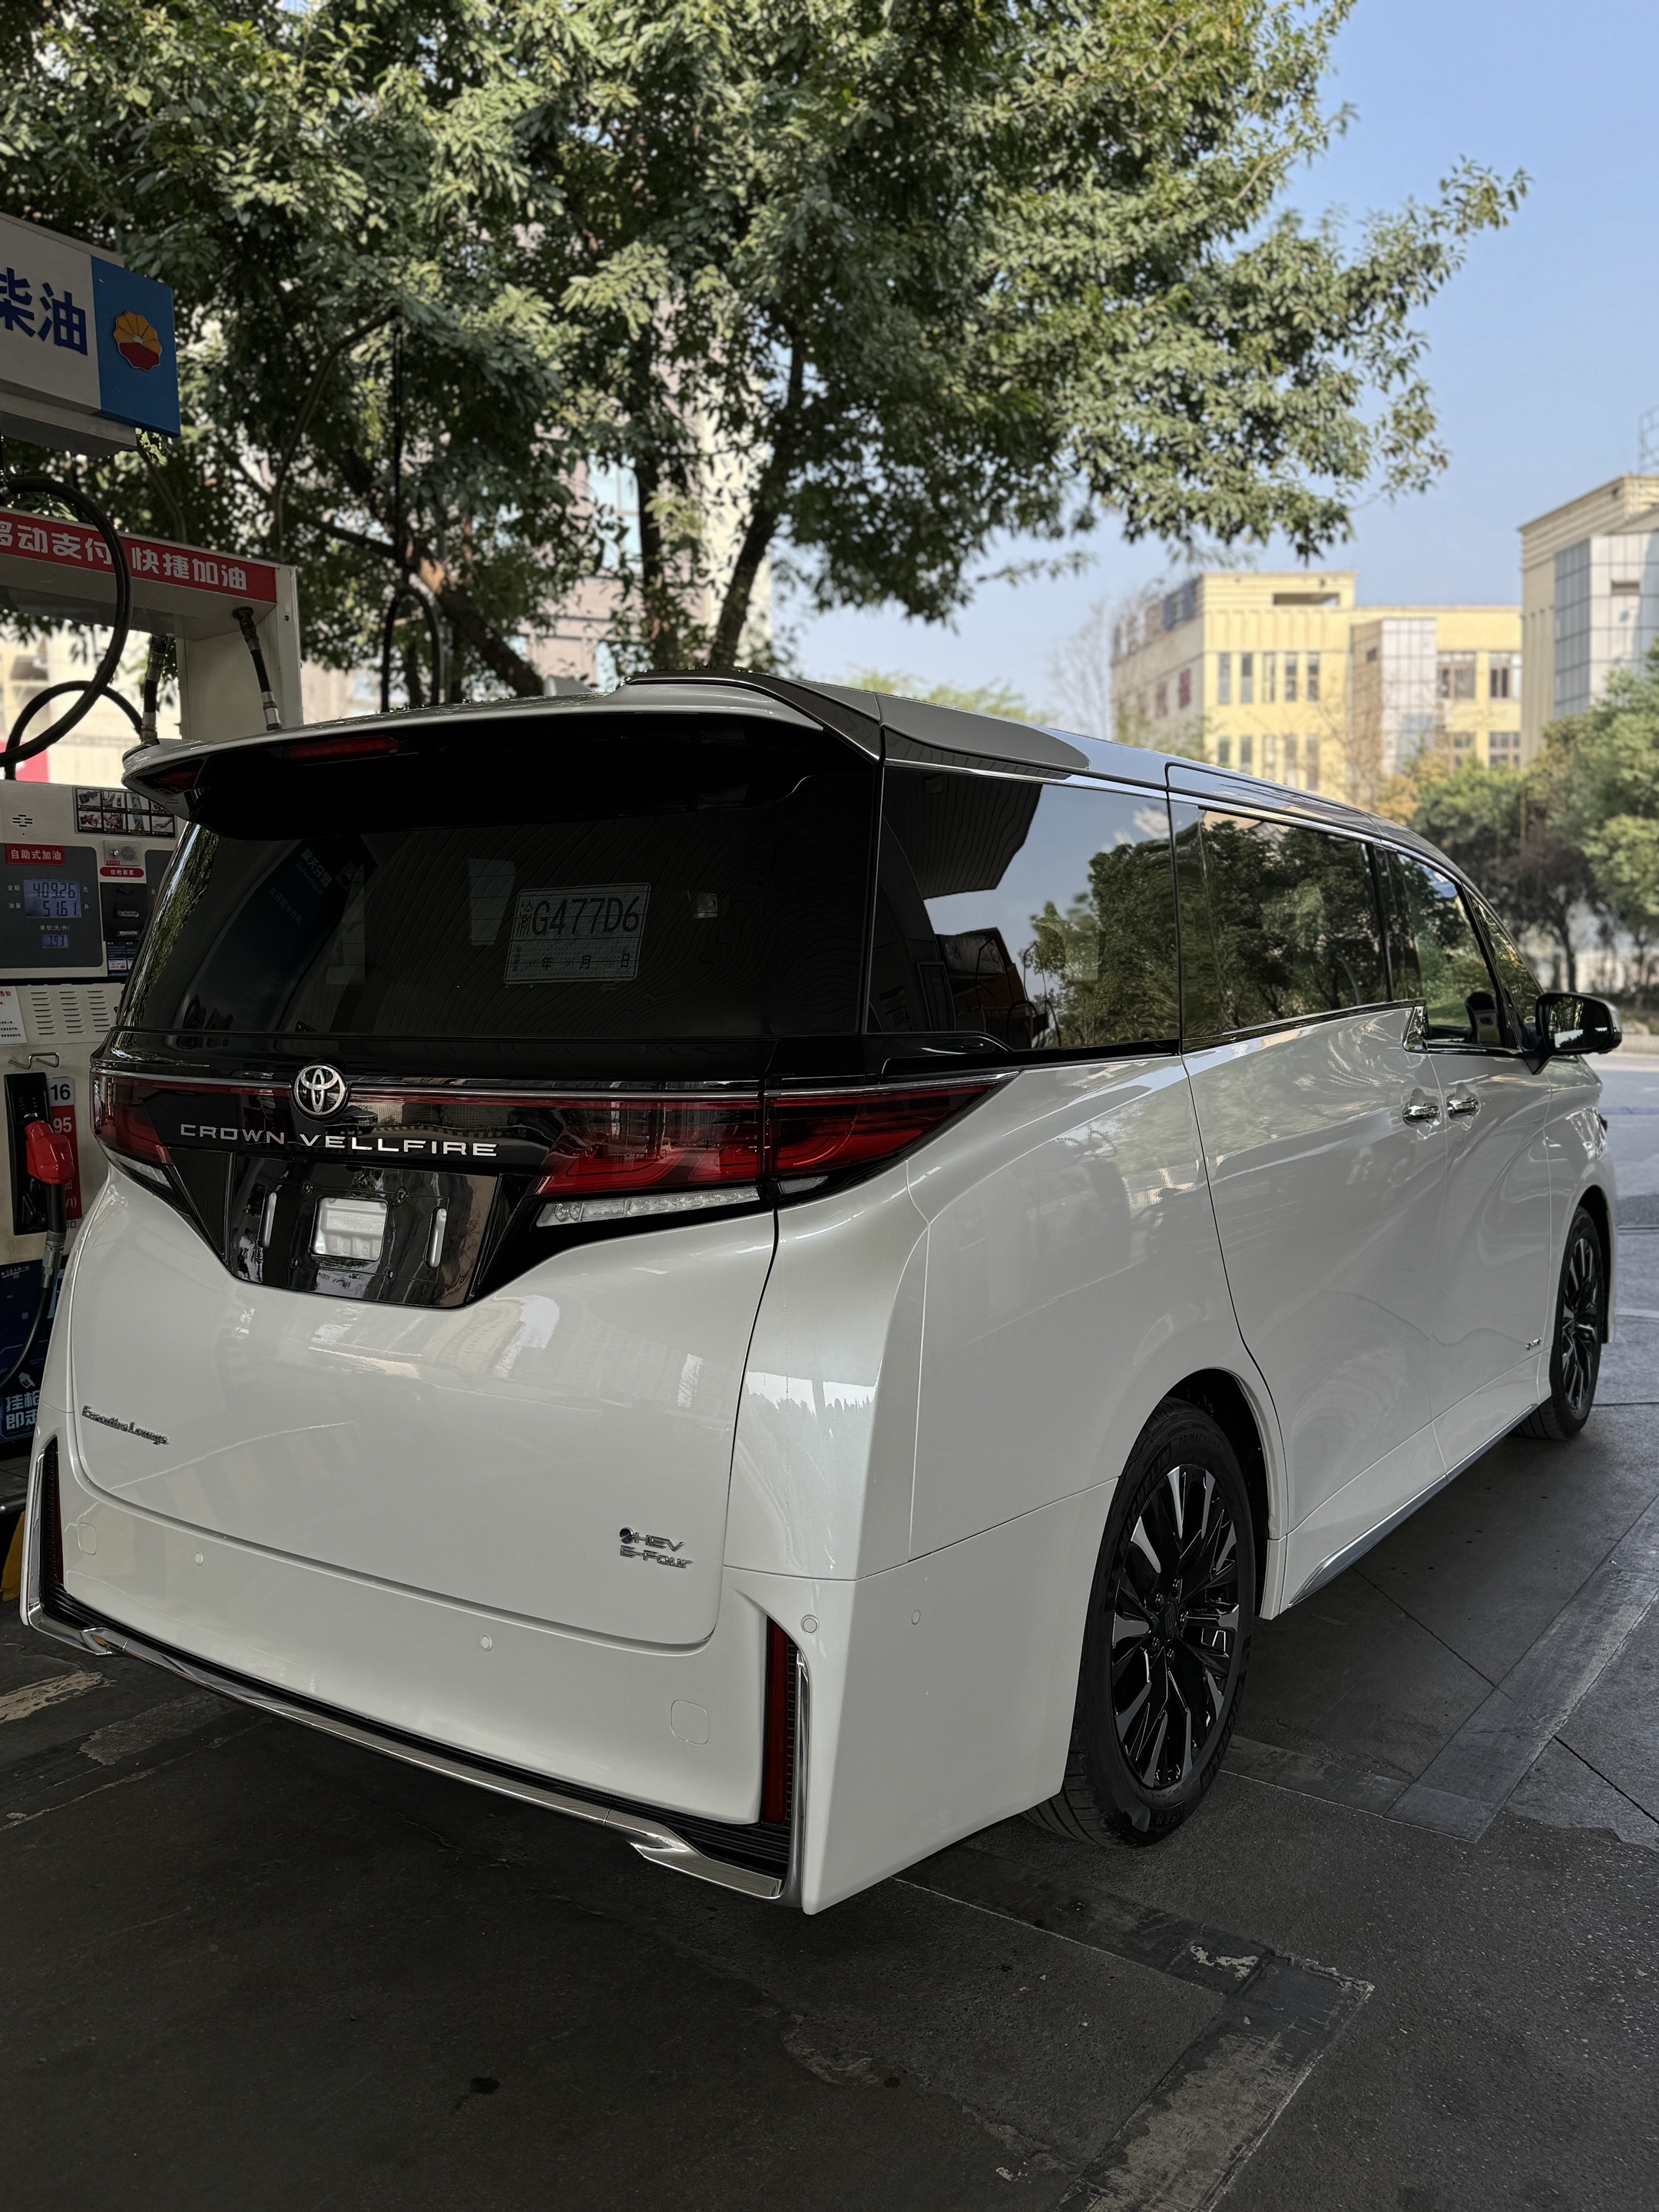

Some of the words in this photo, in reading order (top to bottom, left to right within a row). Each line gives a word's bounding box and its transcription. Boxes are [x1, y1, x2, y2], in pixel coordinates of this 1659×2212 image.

[0, 267, 88, 356] 柴油
[131, 546, 247, 591] 快捷加油
[11, 849, 61, 861] 自助式加油
[516, 896, 640, 936] 渝G477D6
[50, 1084, 71, 1101] 16
[53, 1117, 72, 1134] 95
[180, 1124, 285, 1144] CROWN
[299, 1134, 498, 1157] VELLFIRE
